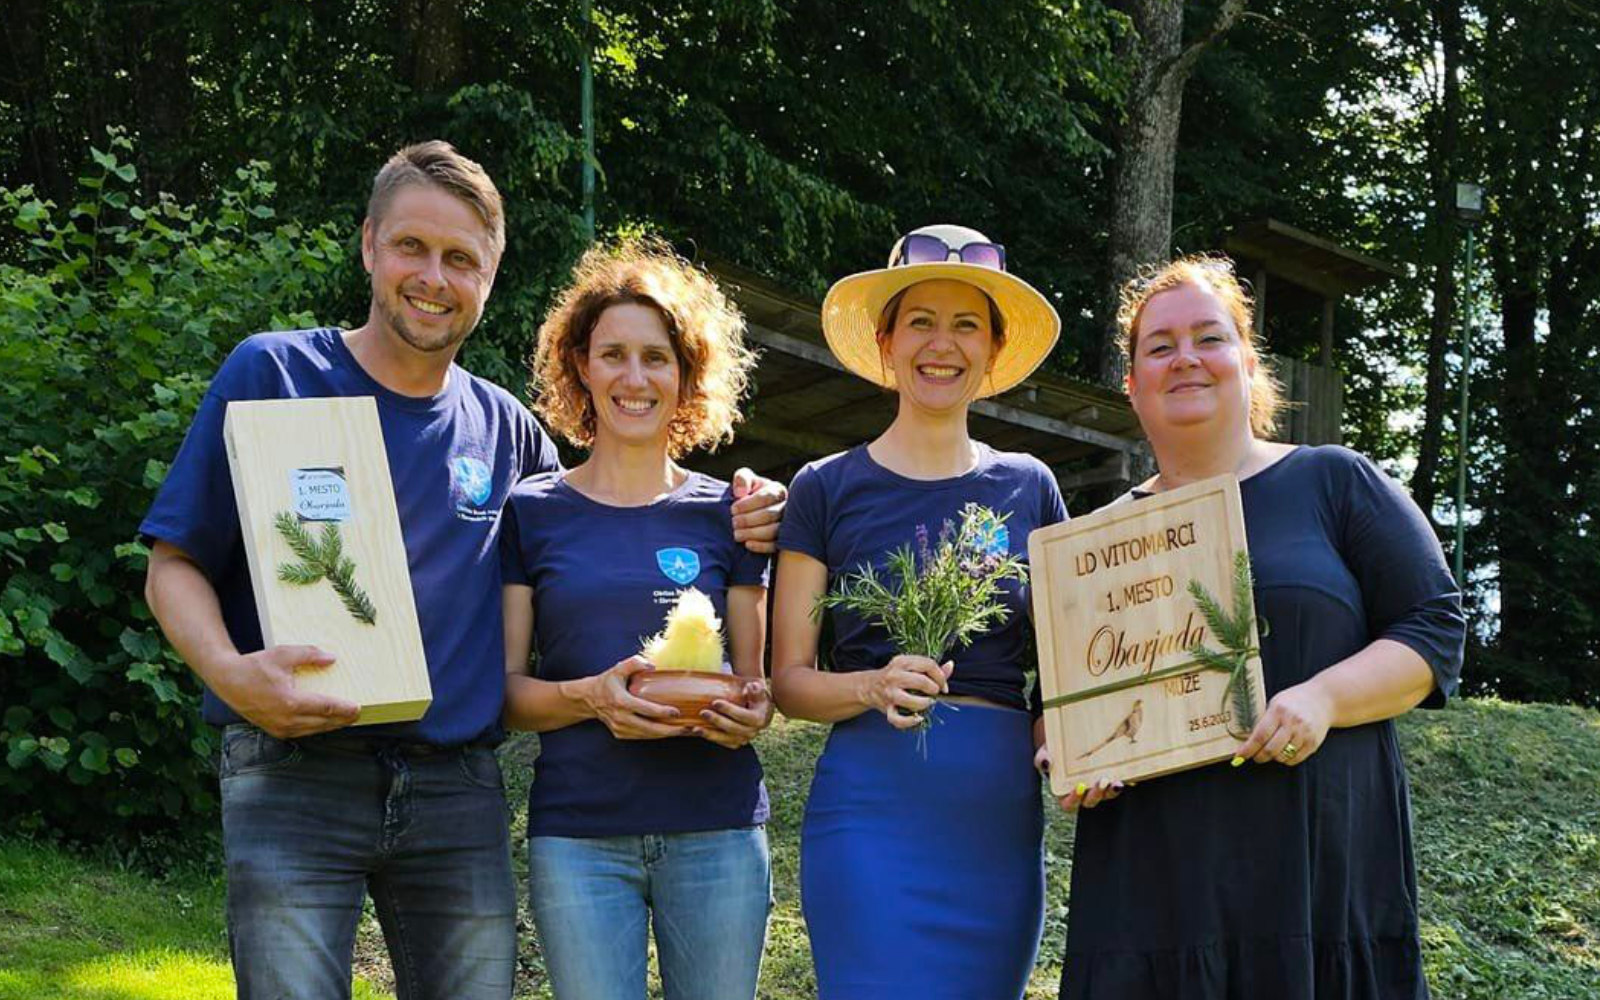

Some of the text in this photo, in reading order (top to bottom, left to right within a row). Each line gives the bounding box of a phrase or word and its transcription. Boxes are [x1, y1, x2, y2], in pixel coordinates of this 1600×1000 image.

[309, 483, 341, 494] MESTO
[1075, 521, 1196, 577] LD VITOMARCI
[1106, 574, 1174, 613] 1. MESTO
[1086, 611, 1206, 678] Obarjada
